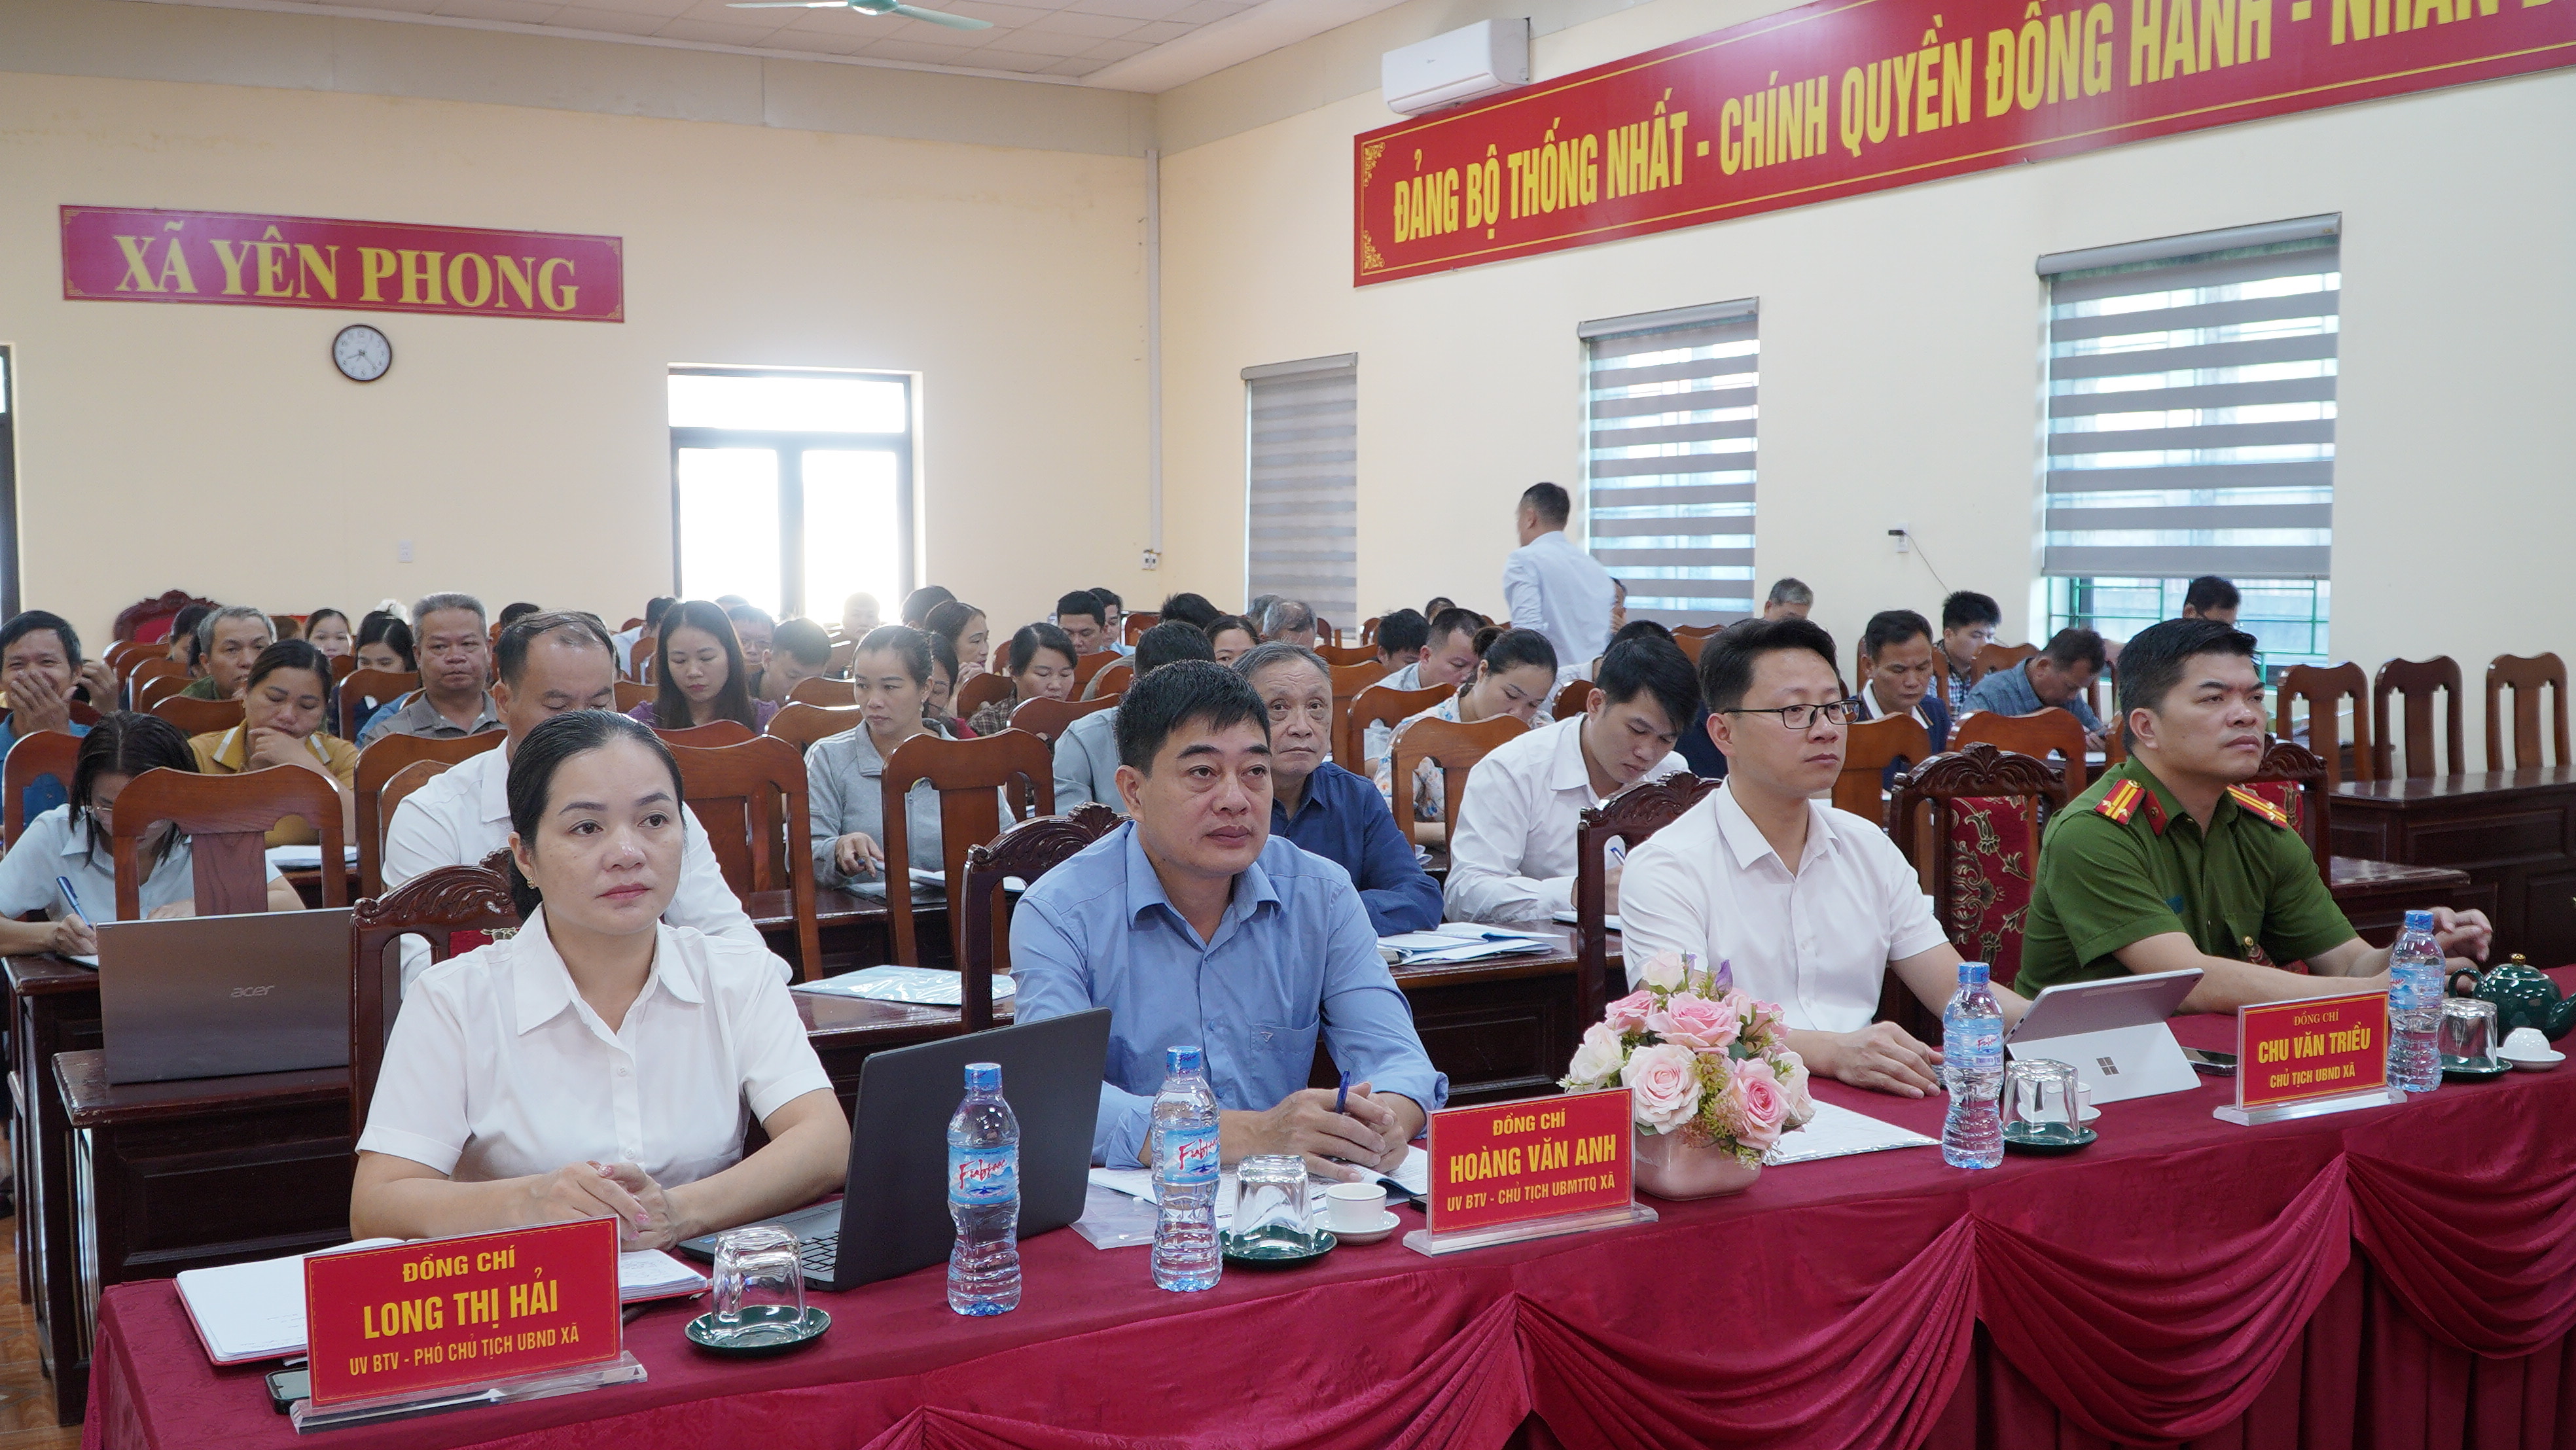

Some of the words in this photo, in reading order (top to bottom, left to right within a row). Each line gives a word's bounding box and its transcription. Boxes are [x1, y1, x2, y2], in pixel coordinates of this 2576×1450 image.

[1393, 150, 1459, 243] ĐẢNG
[1467, 144, 1501, 239] BỘ
[1509, 118, 1597, 220] THỐNG
[1607, 88, 1689, 200] NHẤT
[1720, 71, 1829, 175] CHÍNH
[1841, 14, 1972, 158] QUYỀN
[114, 221, 198, 294] XÃ
[210, 224, 338, 300] YÊN
[358, 247, 577, 311] PHONG
[231, 985, 275, 998] acer
[2294, 1011, 2320, 1026] ĐỒNG
[2323, 1008, 2339, 1022] CHÍ
[2259, 1039, 2289, 1064] CHU
[2294, 1031, 2325, 1059] VĂN
[2329, 1021, 2370, 1055] TRIỀU
[2270, 1068, 2289, 1089] CHỦ
[2292, 1070, 2313, 1088] TỊCH
[2316, 1065, 2340, 1082] UBND
[2343, 1062, 2355, 1078] XÃ
[1493, 1112, 1535, 1137] ĐỒNG
[1541, 1108, 1565, 1129] CHÍ
[1450, 1146, 1521, 1184] HOÀNG
[1528, 1137, 1568, 1173] VĂN
[1575, 1134, 1616, 1166] ANH
[1447, 1196, 1462, 1212] UV
[1465, 1193, 1487, 1209] BTV
[1498, 1181, 1520, 1205] CHỦ
[1524, 1184, 1548, 1203] TỊCH
[1552, 1178, 1596, 1196] UBMTTQ
[1600, 1171, 1615, 1190] XÃ
[402, 1253, 469, 1283] ĐỒNG
[476, 1245, 516, 1272] CHÍ
[364, 1296, 444, 1339] LONG
[453, 1288, 499, 1330] THỊ
[510, 1267, 558, 1317] HẢI
[349, 1357, 368, 1375] UV
[373, 1352, 399, 1373] BTV
[414, 1344, 443, 1366] PHÓ
[448, 1334, 476, 1362] CHỦ
[482, 1335, 512, 1360] TỊCH
[518, 1329, 556, 1351] UBND
[561, 1322, 579, 1344] XÃ
